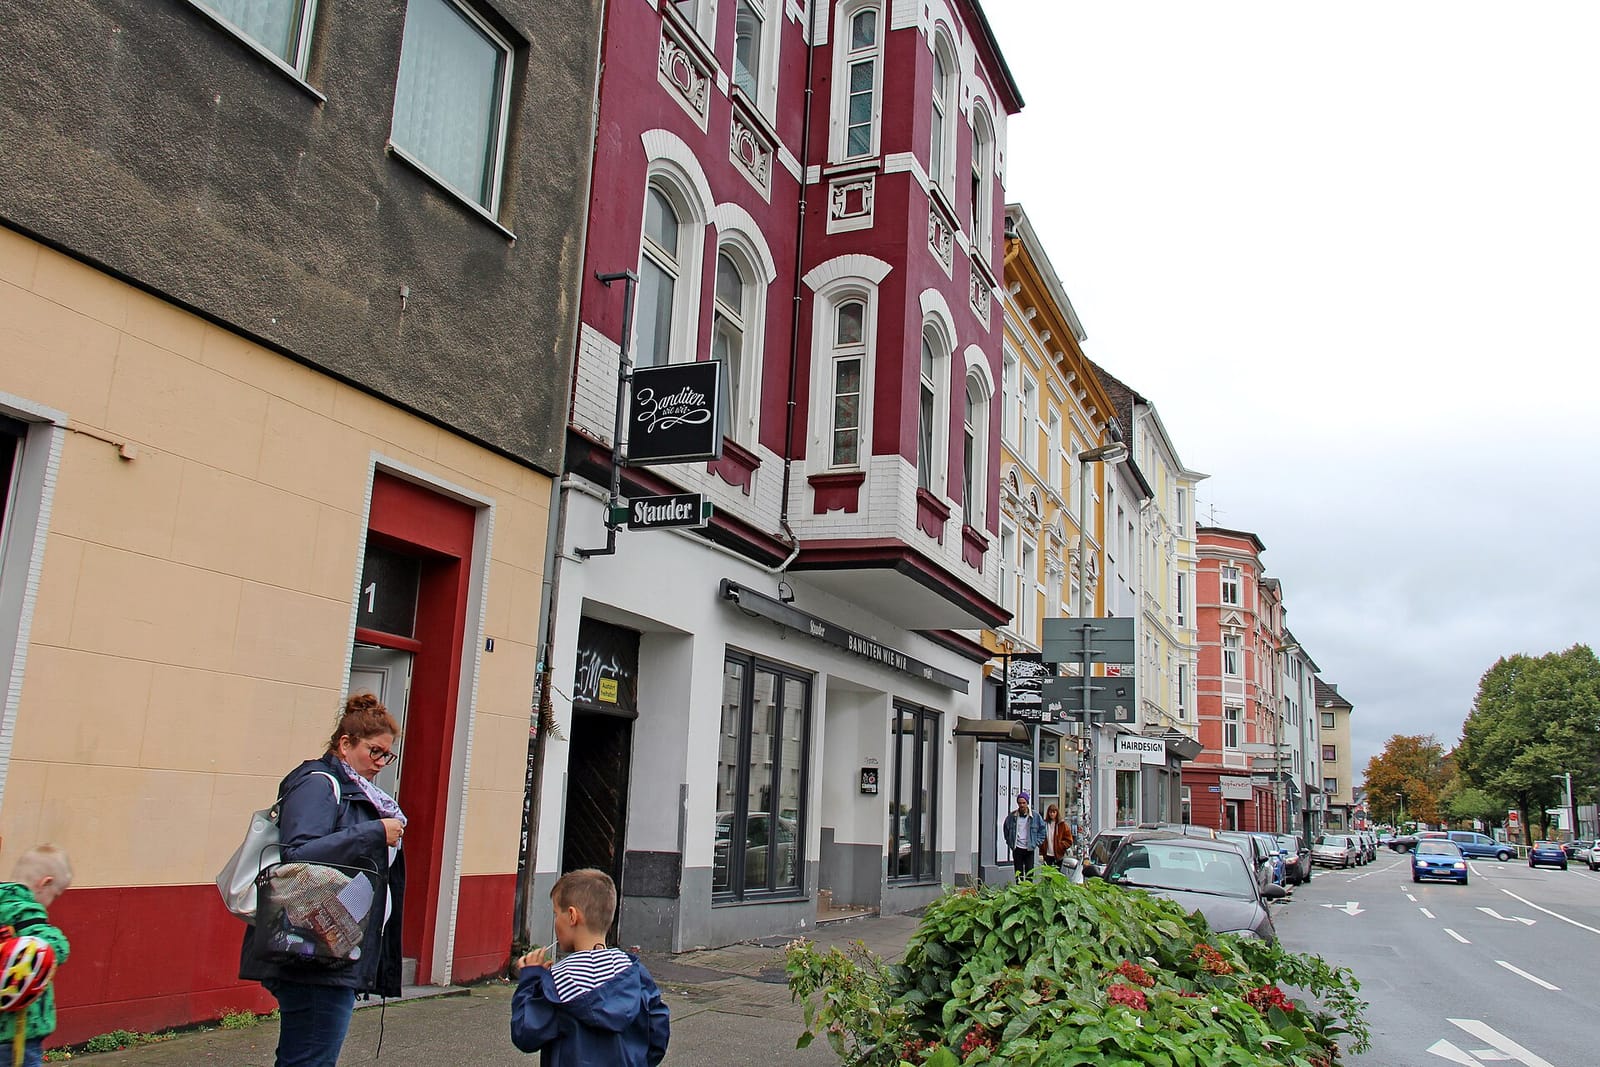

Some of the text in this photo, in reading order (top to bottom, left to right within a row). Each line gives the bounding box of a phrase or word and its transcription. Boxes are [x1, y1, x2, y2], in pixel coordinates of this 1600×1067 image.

[637, 386, 707, 430] Banditen
[634, 498, 692, 525] Stauder
[364, 582, 377, 614] 1
[848, 634, 907, 670] BANDITEN WIE WIR
[1121, 740, 1163, 752] HAIRDESIGN
